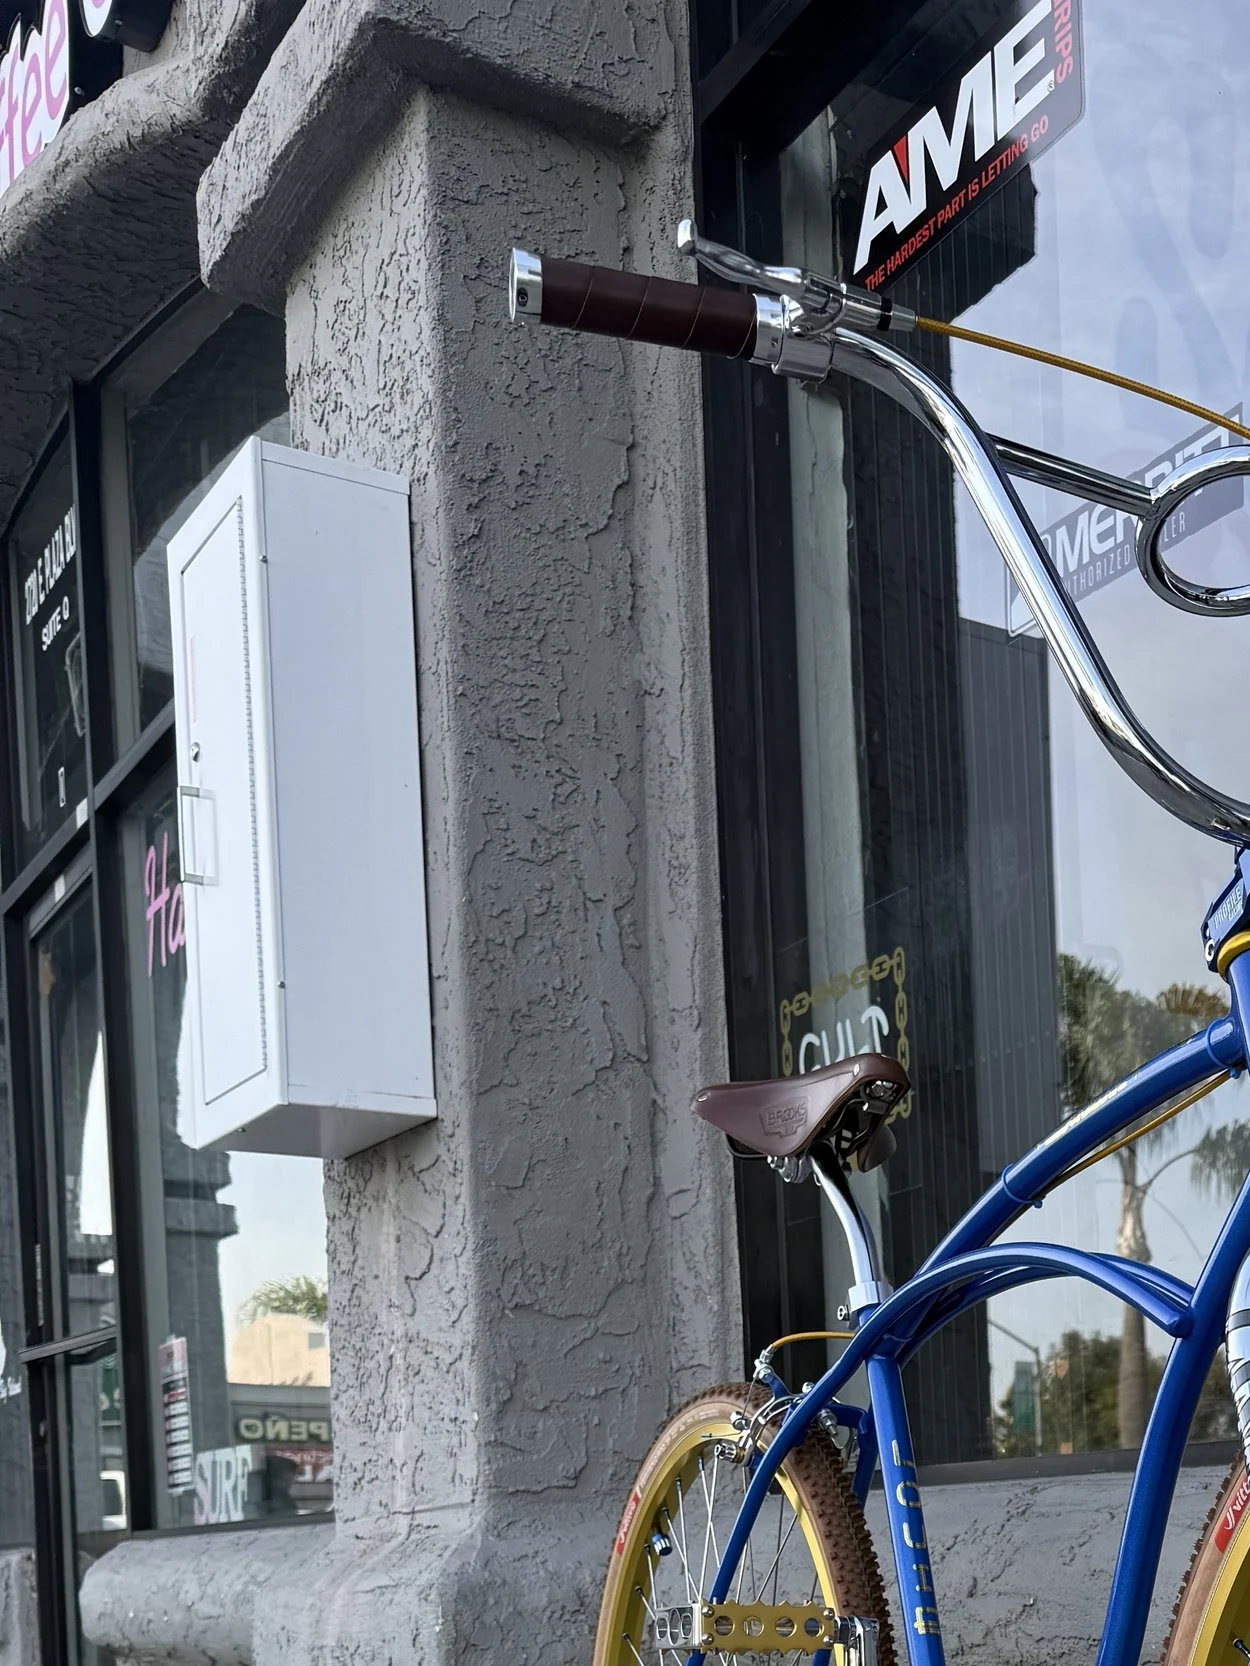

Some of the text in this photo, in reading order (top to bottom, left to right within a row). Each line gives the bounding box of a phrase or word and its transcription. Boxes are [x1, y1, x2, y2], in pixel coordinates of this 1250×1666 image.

[1053, 0, 1073, 84] RIPS
[853, 0, 1054, 275] AME
[864, 114, 1049, 291] THE HARDEST PART IS LETTING GO
[1065, 544, 1131, 591] UTHORIZED
[42, 606, 62, 651] SUITE
[1214, 884, 1242, 930] PROFILE
[800, 1005, 889, 1075] CULT
[767, 1102, 807, 1127] BROOKS
